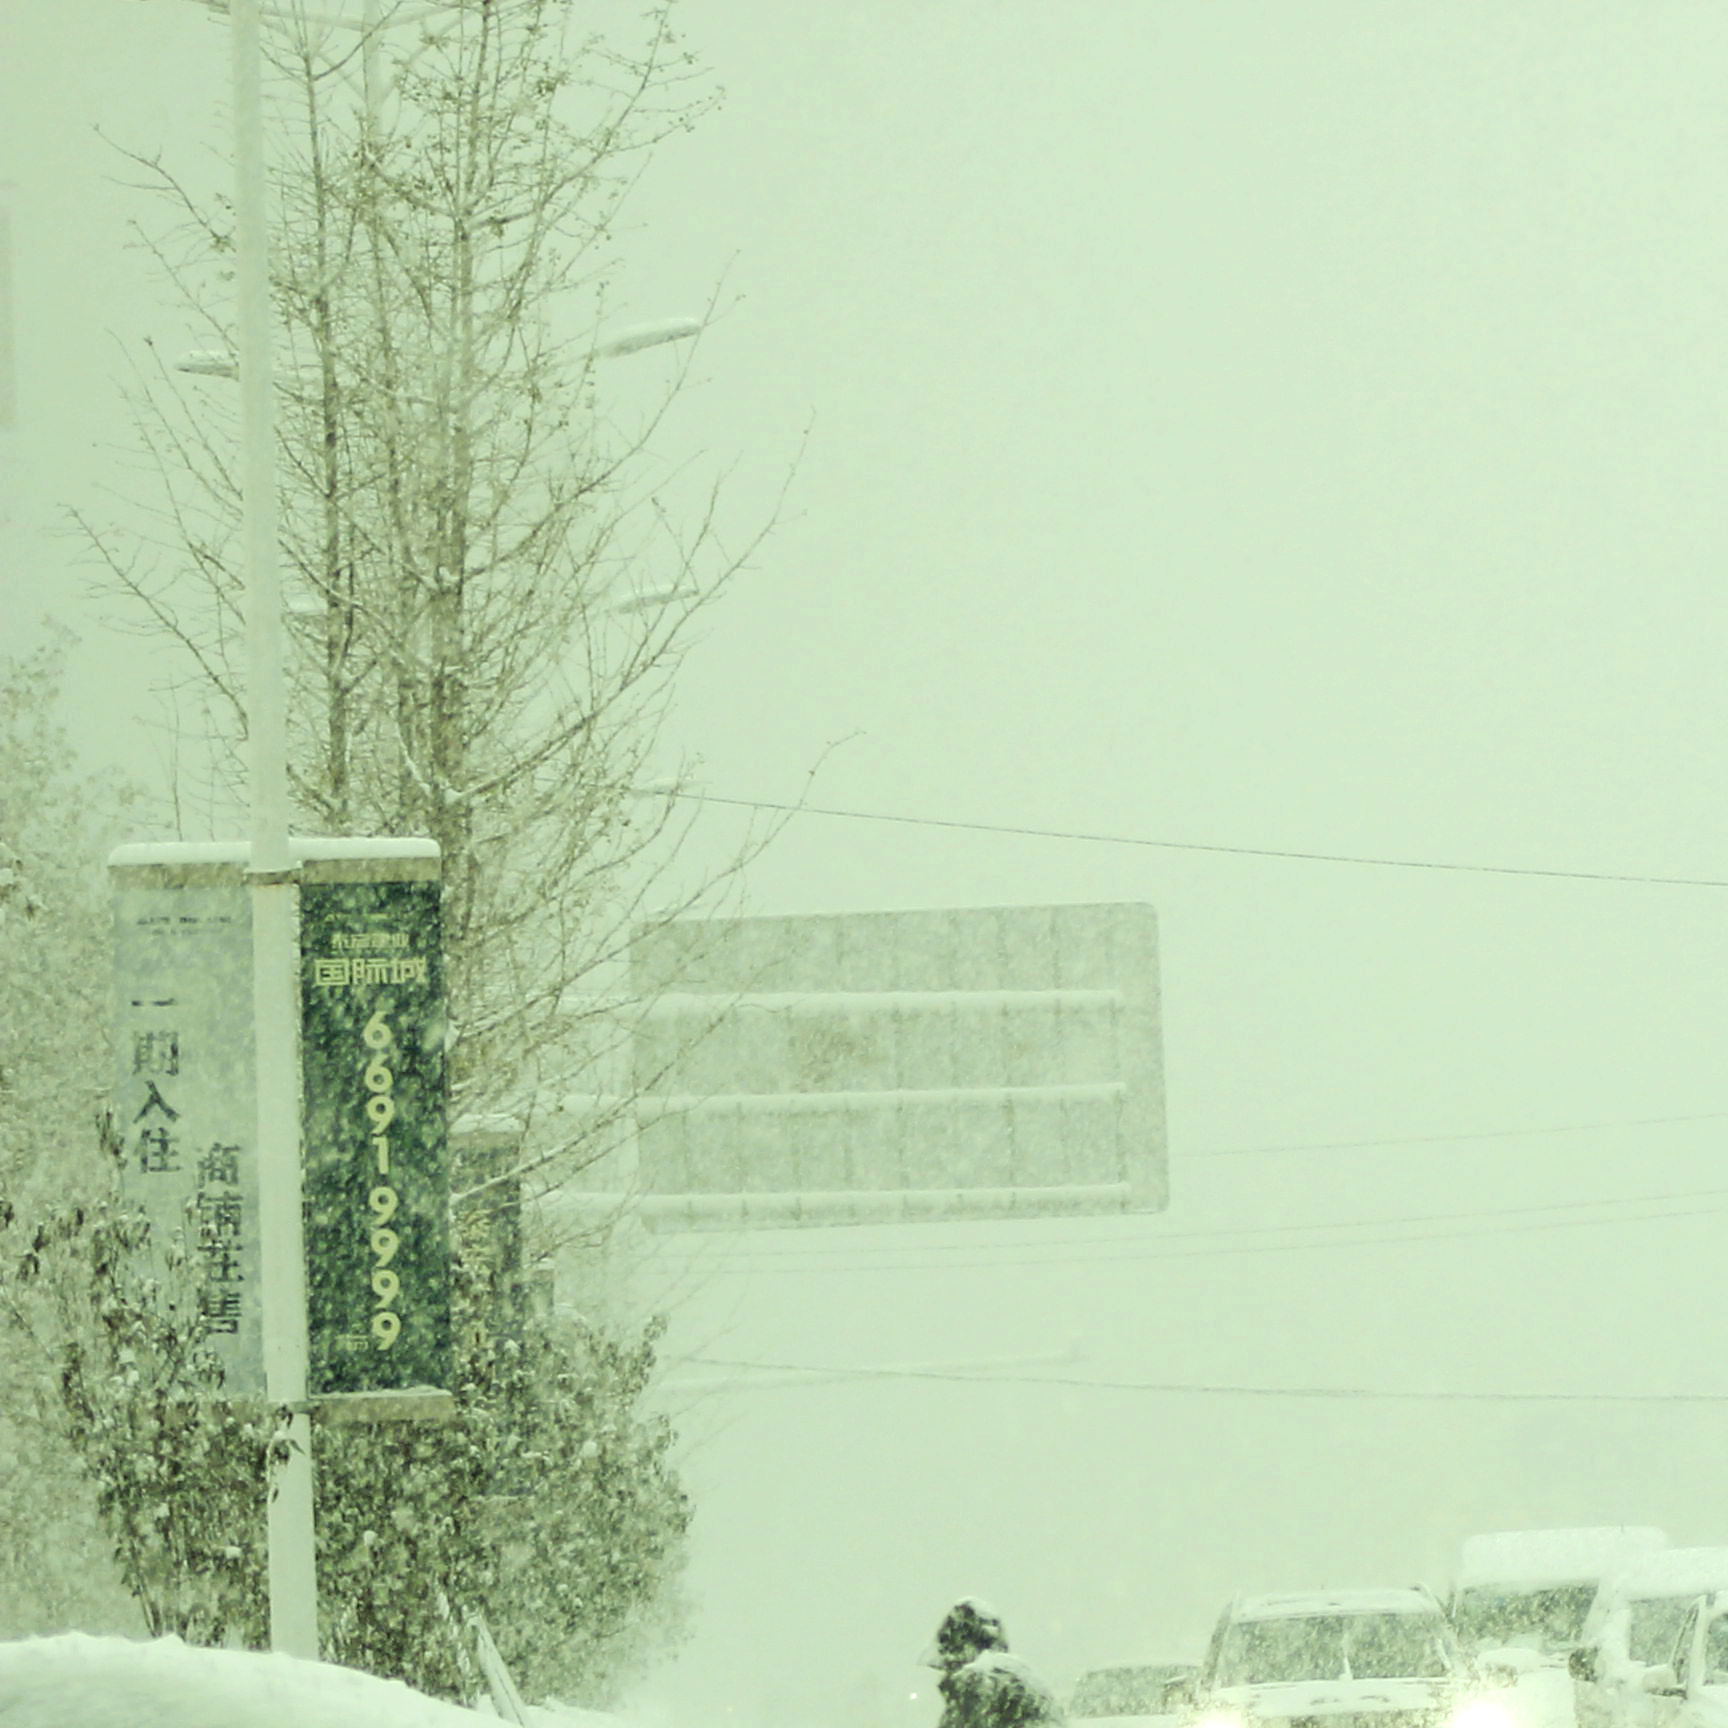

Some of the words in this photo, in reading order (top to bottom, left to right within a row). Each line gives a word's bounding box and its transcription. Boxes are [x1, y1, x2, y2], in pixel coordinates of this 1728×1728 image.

[314, 956, 429, 985] 国际城
[131, 997, 182, 1174] 一期入住
[197, 1141, 246, 1335] 商铺在售
[362, 1010, 401, 1351] 66919999
